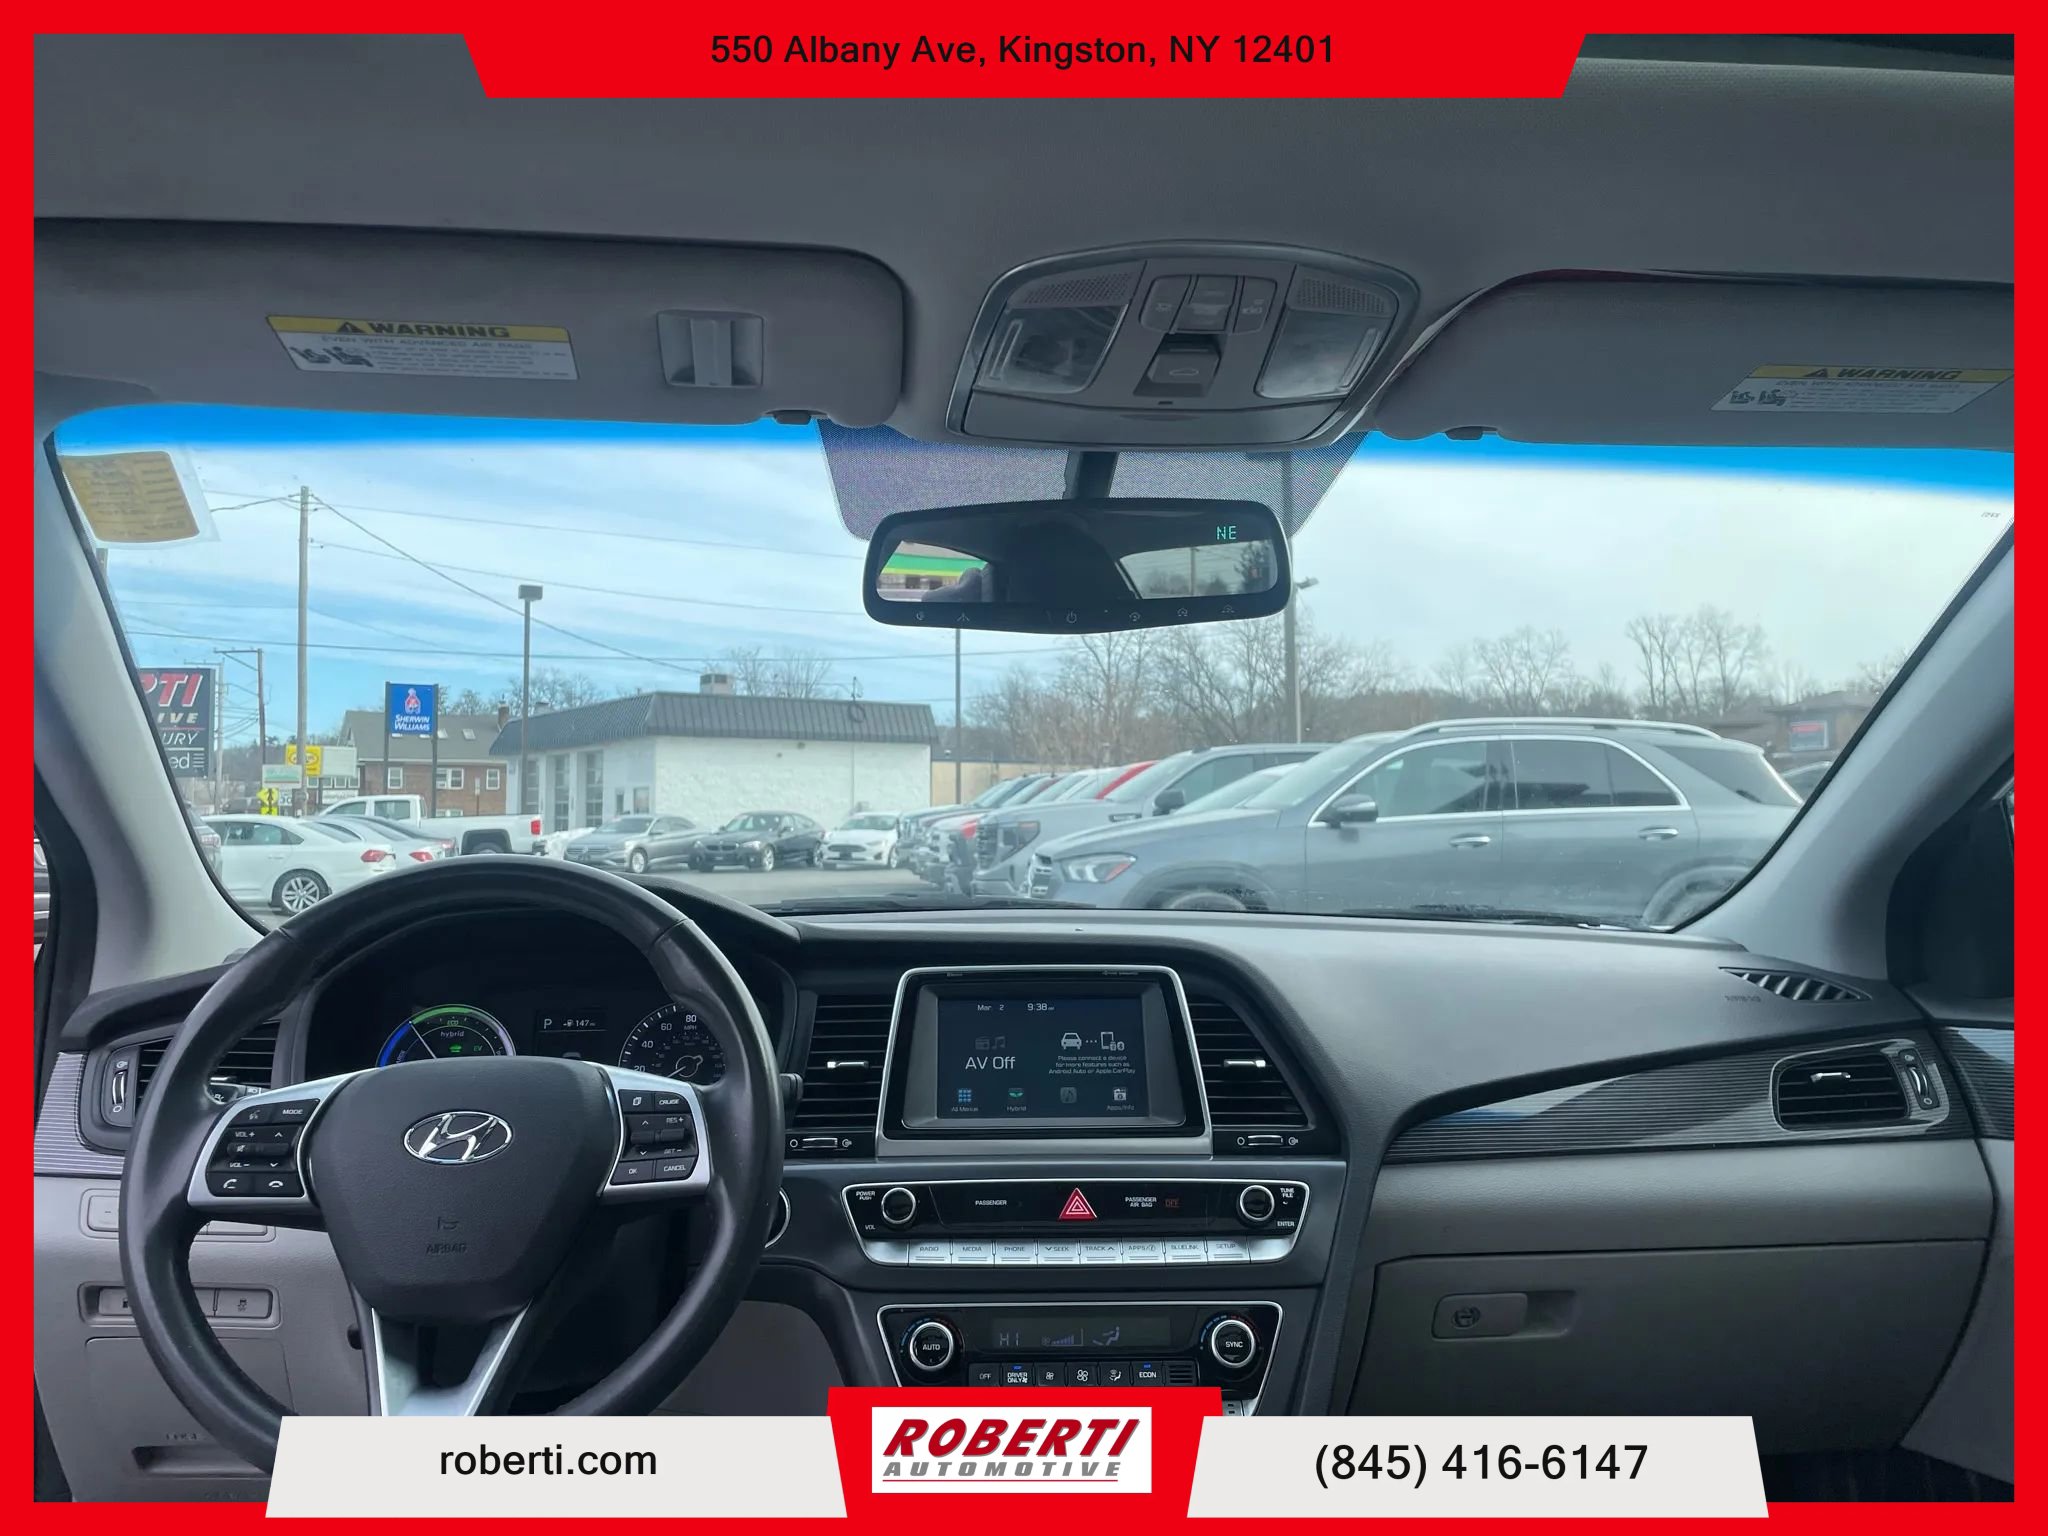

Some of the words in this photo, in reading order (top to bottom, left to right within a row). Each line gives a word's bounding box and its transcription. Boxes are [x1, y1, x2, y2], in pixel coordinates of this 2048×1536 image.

[367, 322, 510, 338] WARNING
[1837, 368, 1963, 380] WARNING
[1216, 525, 1237, 540] NE
[395, 714, 430, 723] SHERWIN
[394, 720, 430, 731] WILLIAMS
[1027, 1003, 1048, 1011] 9:38
[576, 1019, 590, 1027] 147
[685, 1014, 697, 1023] 80
[543, 1018, 553, 1030] P
[660, 1023, 672, 1031] 60
[641, 1040, 654, 1049] 40
[965, 1056, 988, 1070] AV
[992, 1056, 1016, 1070] Off
[663, 1164, 687, 1172] CANCEL
[922, 1343, 941, 1351] AUTO
